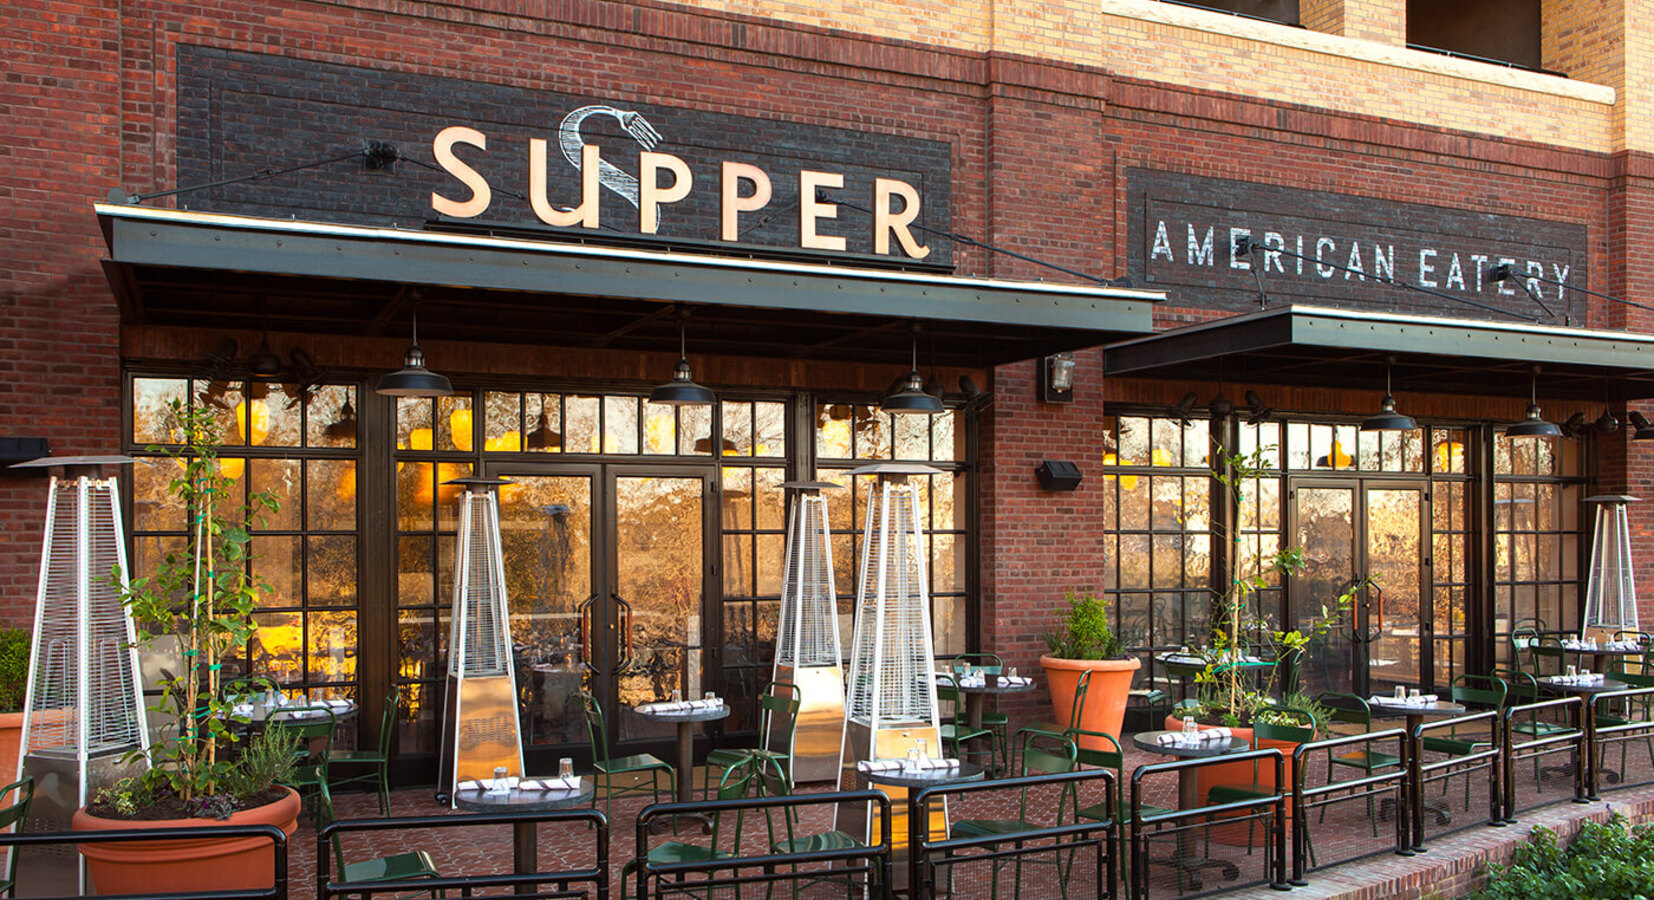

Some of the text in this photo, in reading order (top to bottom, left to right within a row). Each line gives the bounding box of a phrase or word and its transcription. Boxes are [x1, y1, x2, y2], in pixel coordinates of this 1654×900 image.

[432, 125, 931, 259] SUPPER
[1151, 220, 1570, 300] AMERICAN EATERY
